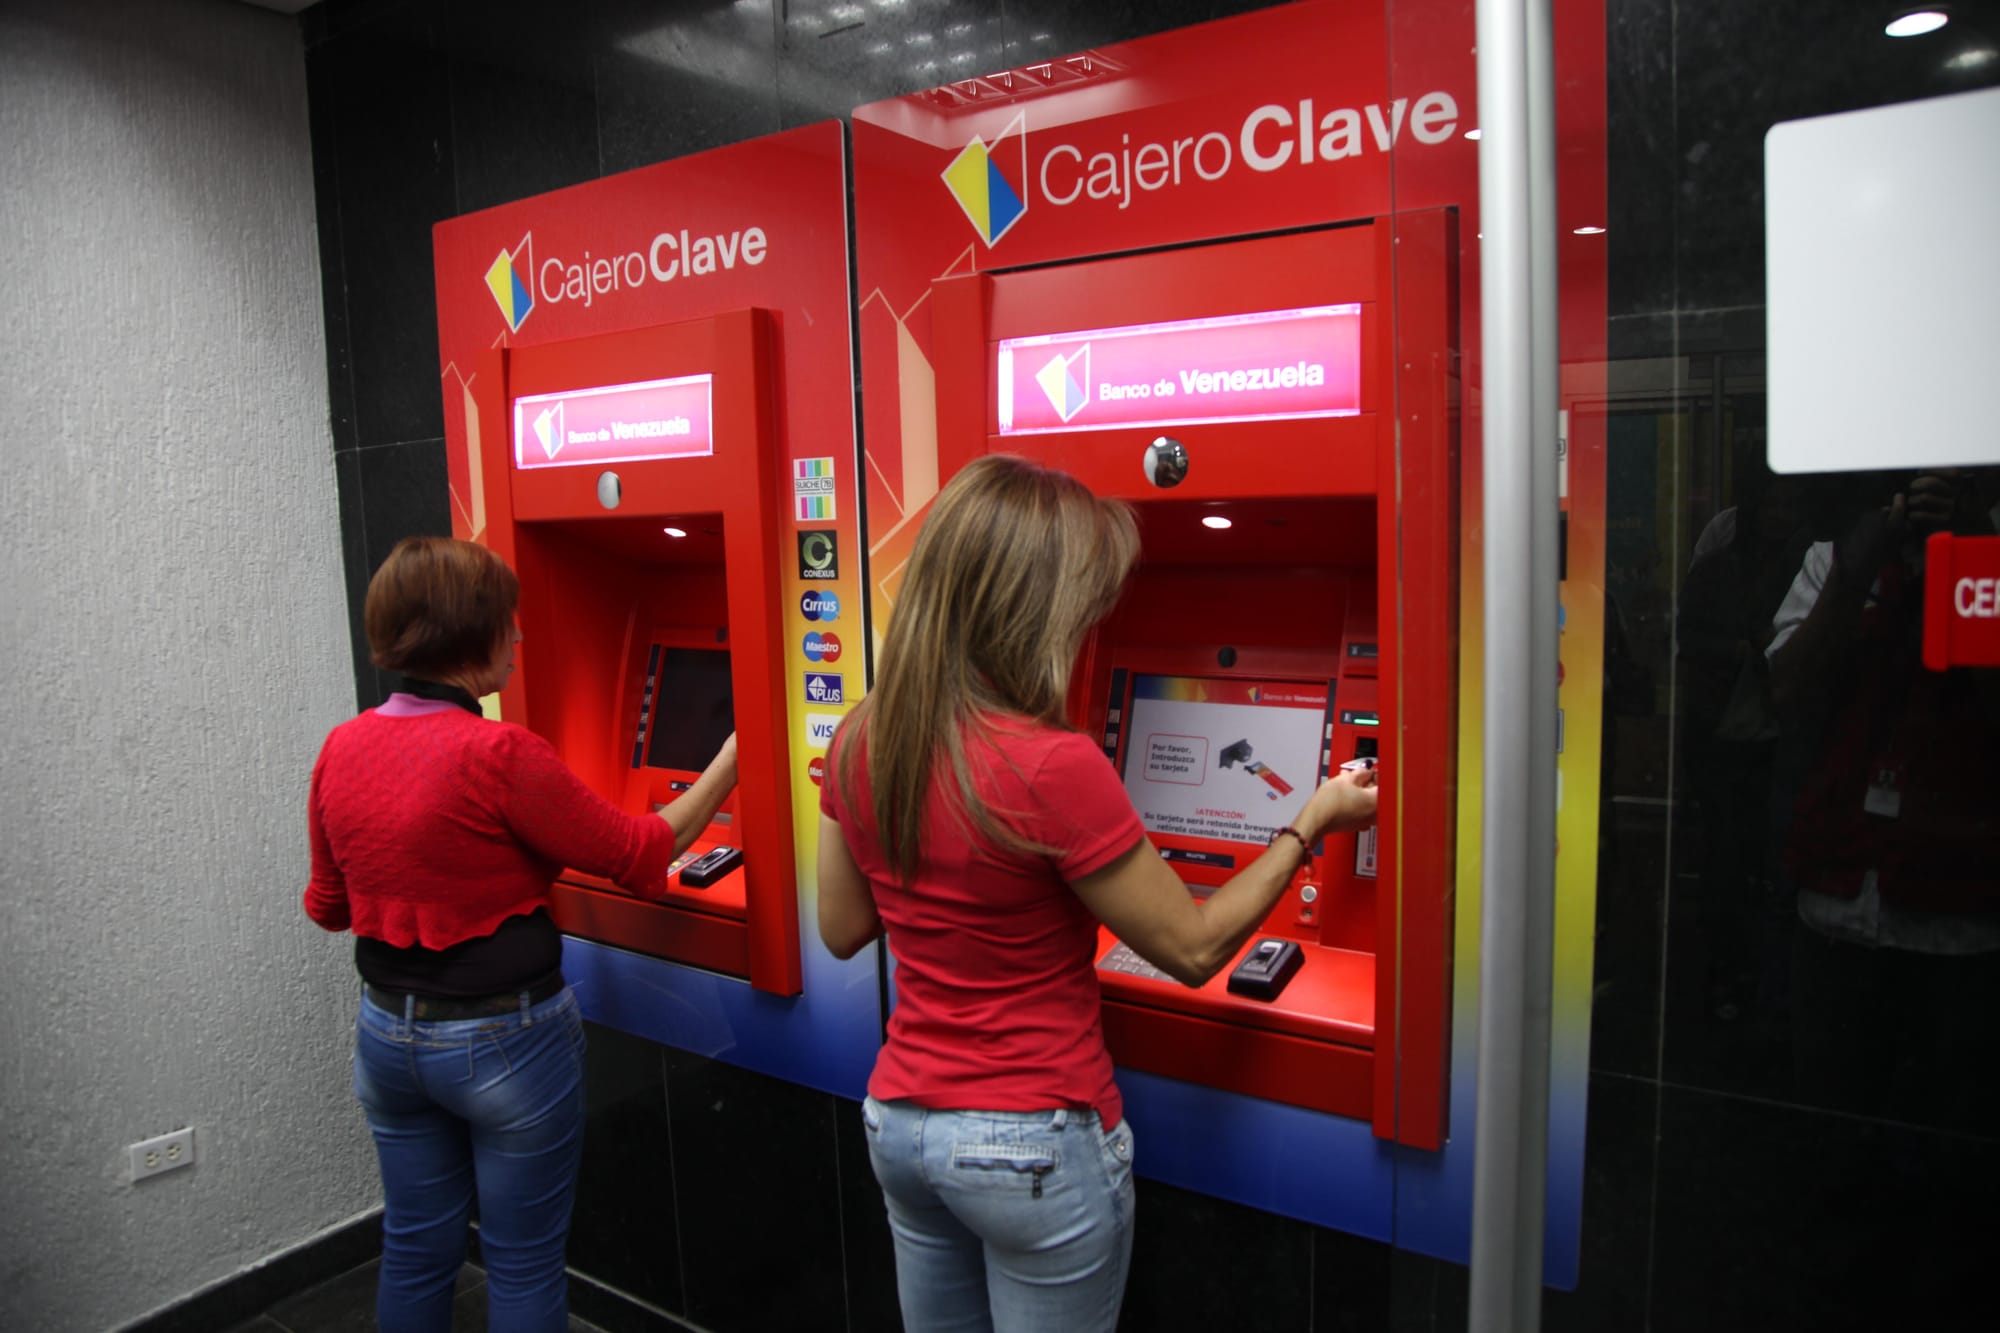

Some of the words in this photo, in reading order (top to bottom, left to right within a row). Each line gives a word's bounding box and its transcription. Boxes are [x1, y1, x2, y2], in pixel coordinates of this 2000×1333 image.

[1100, 383, 1150, 401] Banco
[1153, 379, 1175, 396] de
[1179, 361, 1324, 395] Venezuela
[568, 430, 597, 444] Banco
[598, 428, 610, 441] de
[610, 416, 690, 440] Venezuela
[803, 570, 835, 578] CONEXUS
[803, 598, 837, 612] Cirrus
[806, 641, 839, 653] Maestro
[817, 687, 841, 702] PLUS
[812, 723, 834, 738] VIS
[1152, 743, 1166, 751] Por
[1161, 763, 1189, 773] tarjeta
[1144, 812, 1155, 820] Su
[1156, 814, 1185, 824] tarjeta
[1186, 816, 1205, 825] será
[1206, 820, 1242, 830] retenida
[1244, 823, 1276, 833] brevem
[1157, 823, 1187, 833] retirela
[1188, 827, 1220, 837] cuando
[1221, 829, 1229, 838] le
[1231, 832, 1247, 840] sea
[1248, 833, 1269, 843] indic
